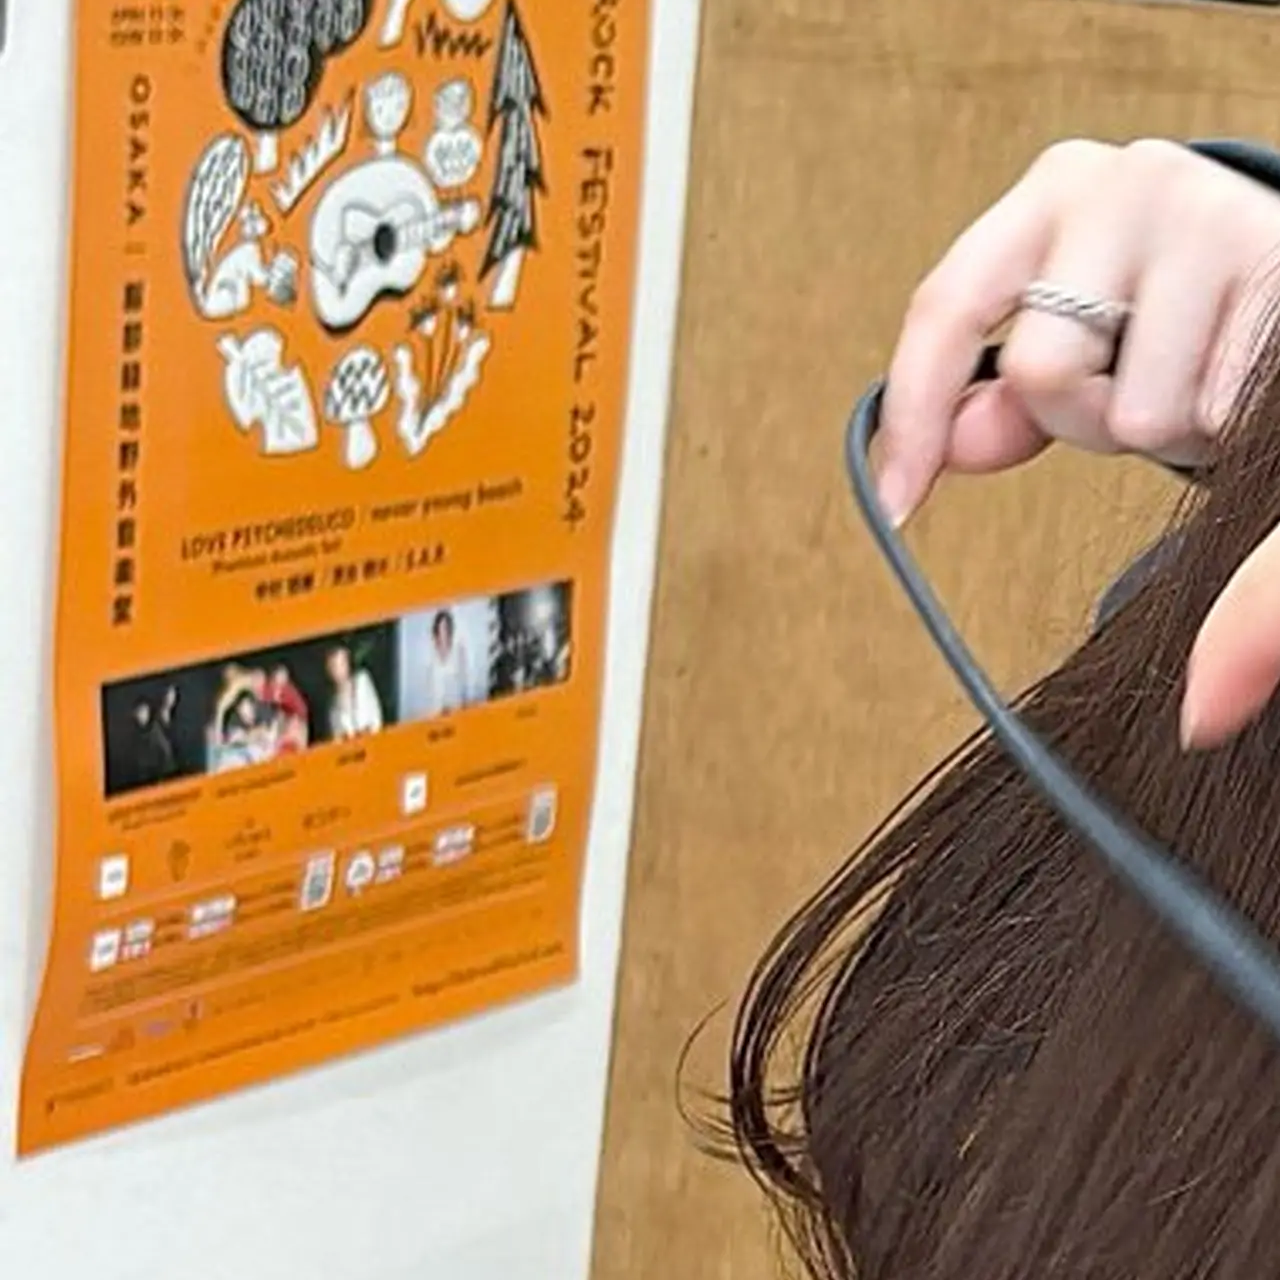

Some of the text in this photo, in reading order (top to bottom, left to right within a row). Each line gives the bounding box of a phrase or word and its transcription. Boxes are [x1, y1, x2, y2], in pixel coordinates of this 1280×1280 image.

[126, 74, 151, 226] OSAKA
[573, 144, 614, 384] FESTIVAL
[563, 402, 596, 532] 2024
[181, 530, 227, 561] LOVE
